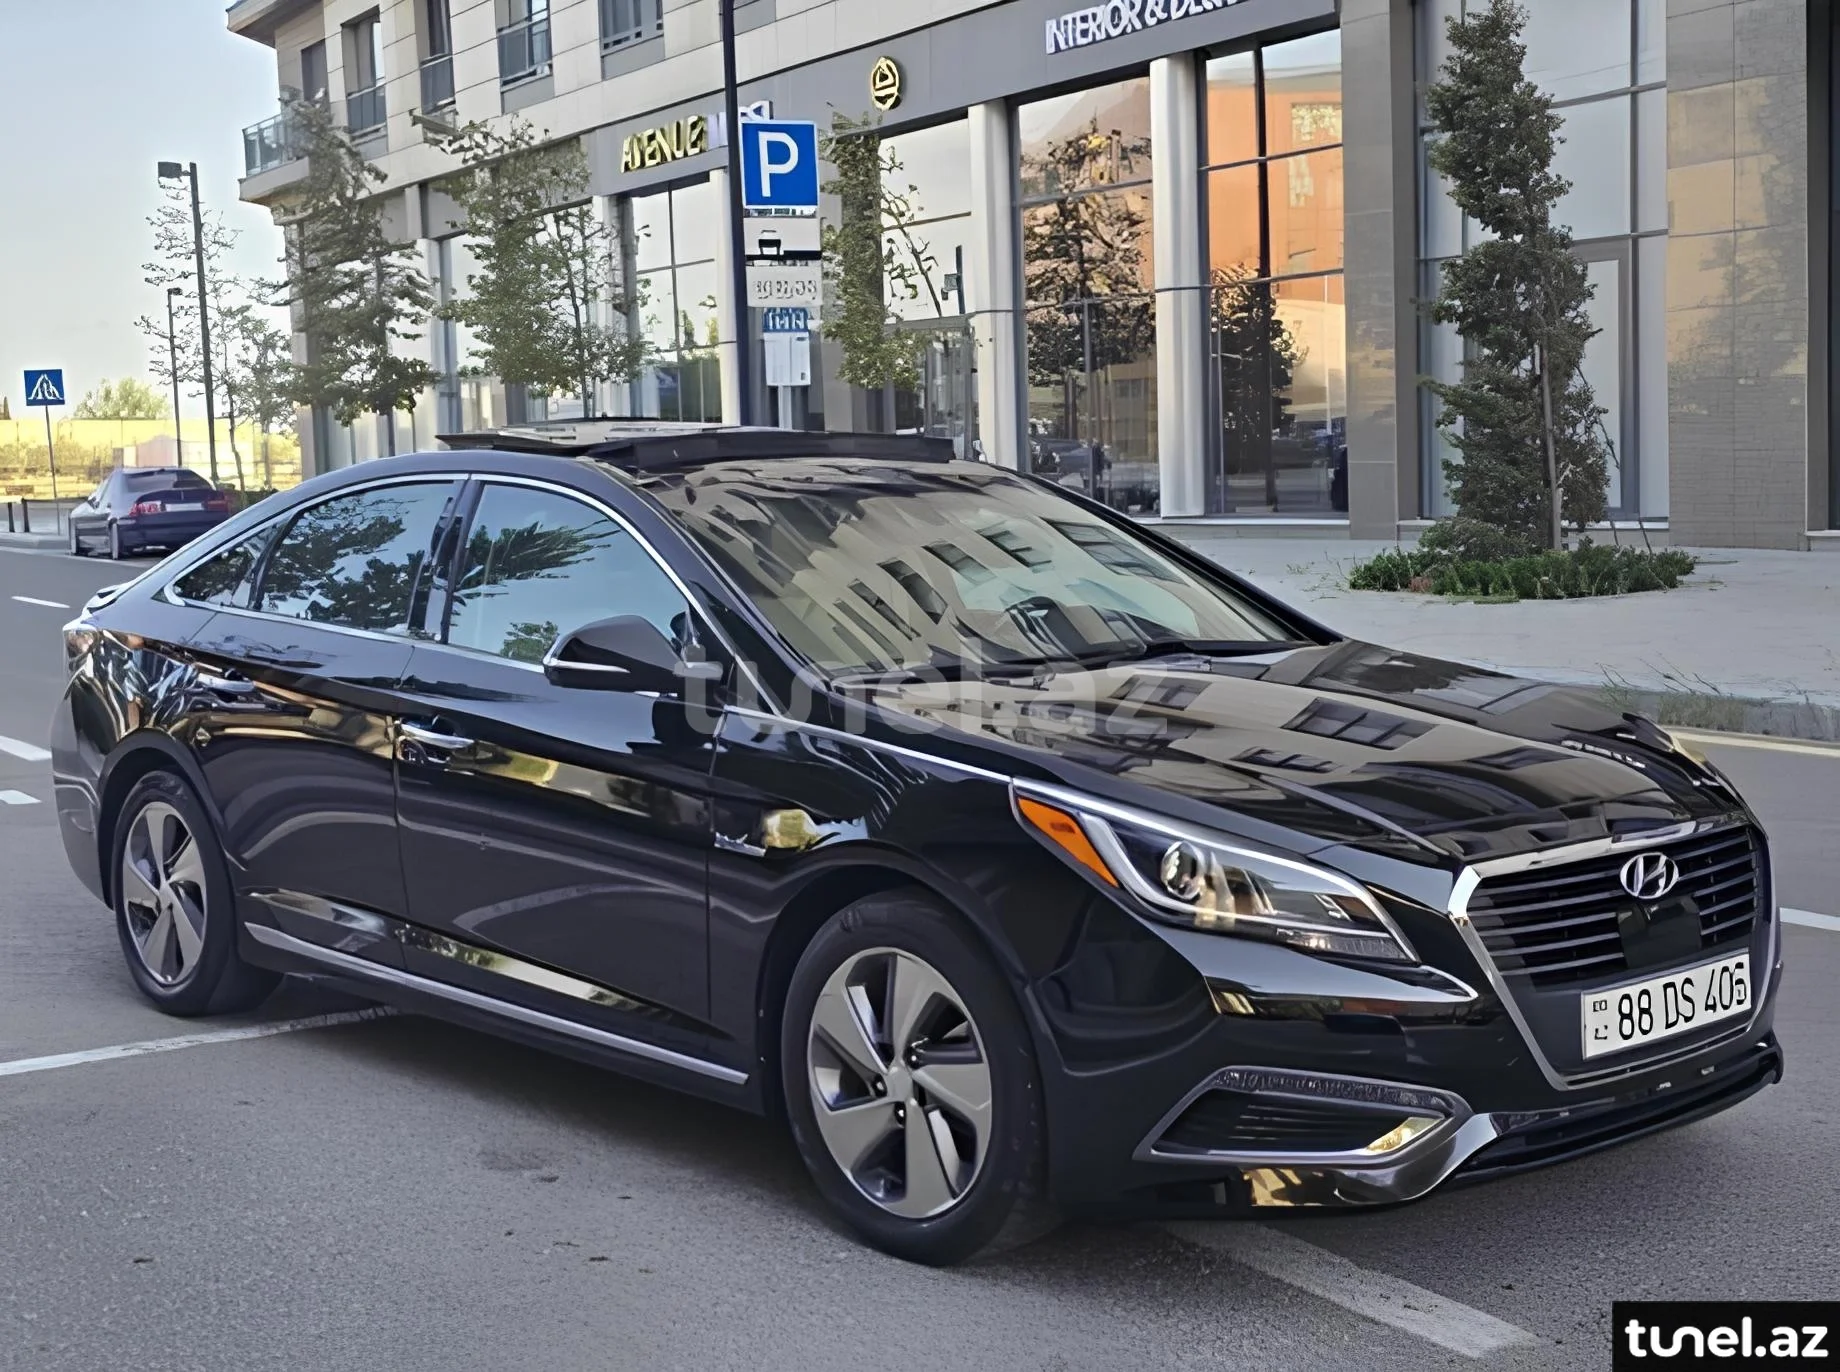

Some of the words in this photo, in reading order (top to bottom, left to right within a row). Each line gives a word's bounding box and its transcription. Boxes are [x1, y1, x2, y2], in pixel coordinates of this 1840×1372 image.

[758, 131, 799, 197] P
[1618, 988, 1653, 1040] 88
[1663, 977, 1695, 1030] DS
